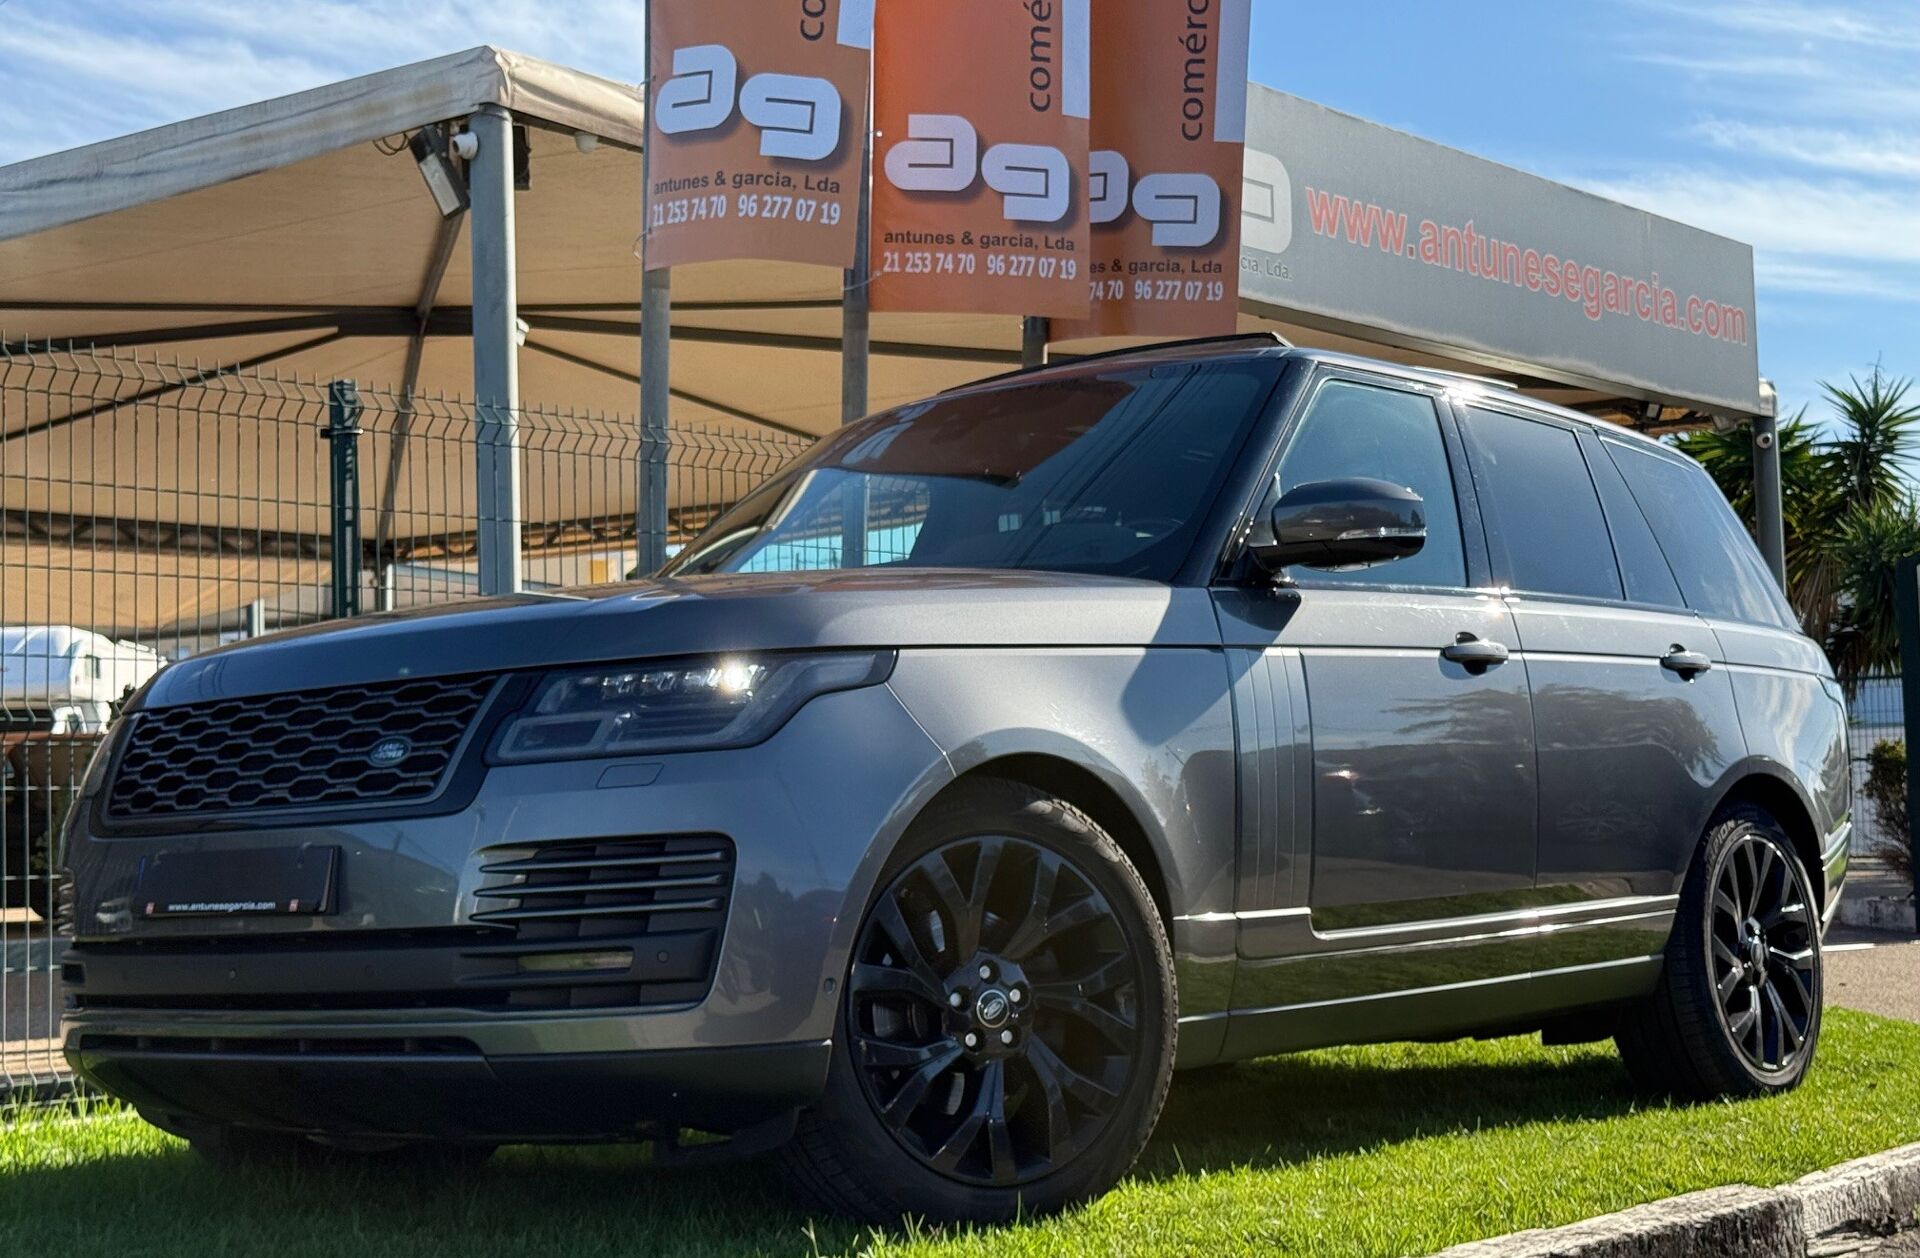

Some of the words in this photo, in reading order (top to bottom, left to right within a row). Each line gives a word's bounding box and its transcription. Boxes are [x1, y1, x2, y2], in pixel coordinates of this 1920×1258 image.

[654, 175, 709, 194] antunes
[714, 171, 726, 186] &
[732, 172, 797, 190] garcia,
[804, 175, 840, 193] Lda
[667, 199, 688, 224] 253
[691, 197, 706, 220] 74
[709, 195, 726, 218] 70
[738, 193, 757, 218] 96
[761, 194, 793, 219] 277
[795, 198, 817, 222] 07
[820, 202, 841, 225] 19
[884, 231, 955, 245] antunes
[961, 231, 974, 245] &
[979, 233, 1038, 249] garcia,
[1044, 235, 1075, 251] Lda
[883, 252, 900, 273] 21
[904, 252, 931, 273] 253
[935, 253, 953, 274] 74
[957, 253, 975, 274] 70
[987, 254, 1005, 275] 96
[1009, 256, 1035, 277] 277
[1038, 257, 1056, 279] 07
[1060, 259, 1076, 280] 19
[1111, 259, 1122, 272] &
[1128, 260, 1185, 275] garcia,
[1191, 260, 1222, 274] Lda
[1305, 187, 1748, 346] www.antunesegarcia.com
[1089, 281, 1104, 300] 74
[1107, 280, 1123, 300] 70
[1134, 280, 1152, 300] 96
[1156, 281, 1182, 300] 277
[1185, 281, 1202, 300] 07
[1206, 281, 1223, 300] 19
